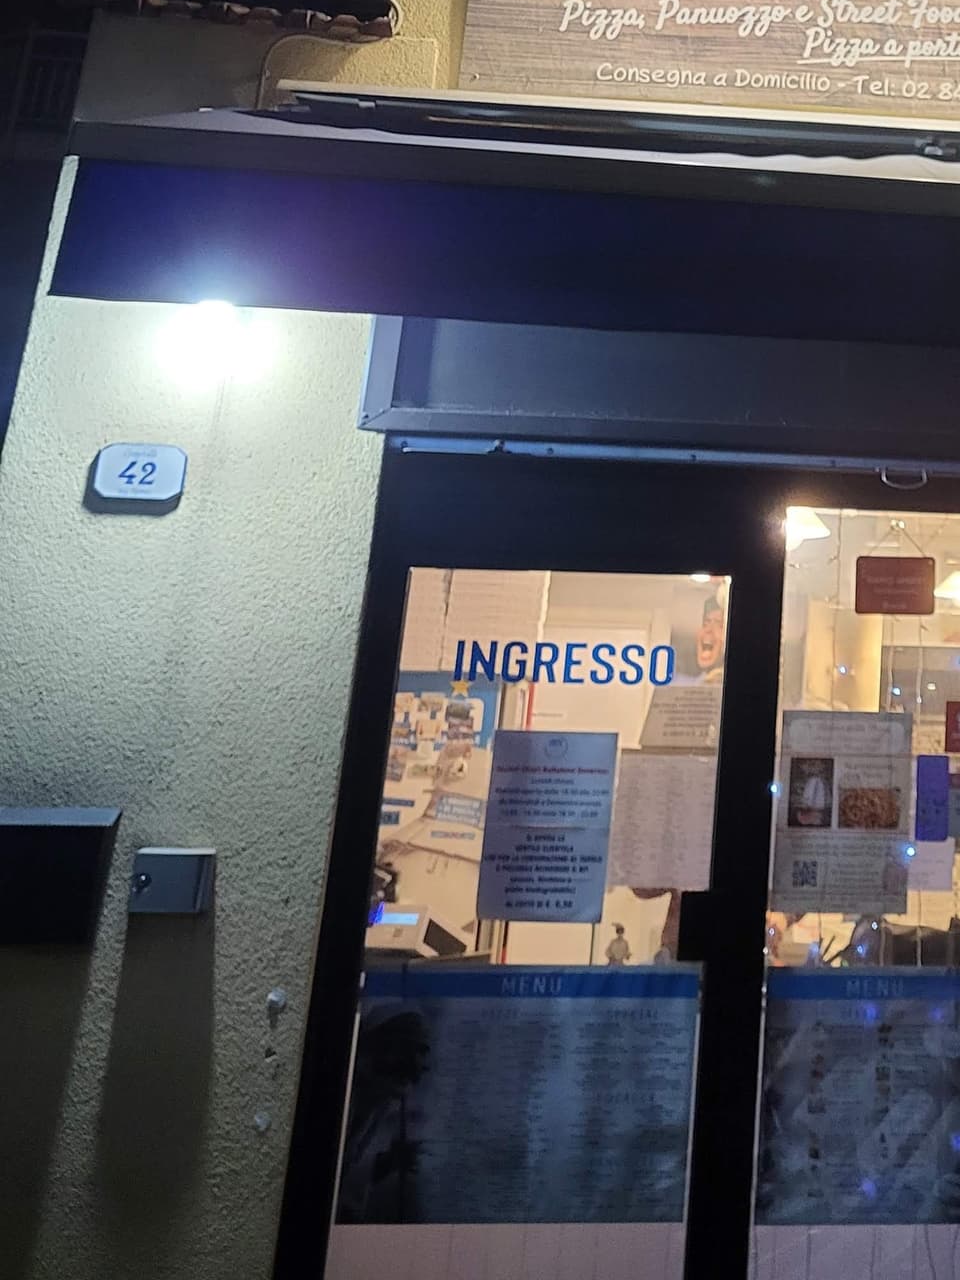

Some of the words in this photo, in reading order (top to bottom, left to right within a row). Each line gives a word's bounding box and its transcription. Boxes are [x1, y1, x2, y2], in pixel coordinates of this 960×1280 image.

[558, 0, 645, 40] Pizza,
[796, 6, 813, 24] e
[801, 27, 881, 66] Pizza
[884, 39, 905, 58] a
[596, 61, 707, 88] Consegna
[713, 72, 728, 87] a
[734, 68, 831, 93] Domicilio
[853, 74, 898, 98] Tel:
[901, 80, 932, 100] 02
[118, 458, 158, 486] 42
[453, 638, 676, 687] INGRESSO
[500, 976, 564, 995] MENU
[845, 978, 904, 997] MENU
